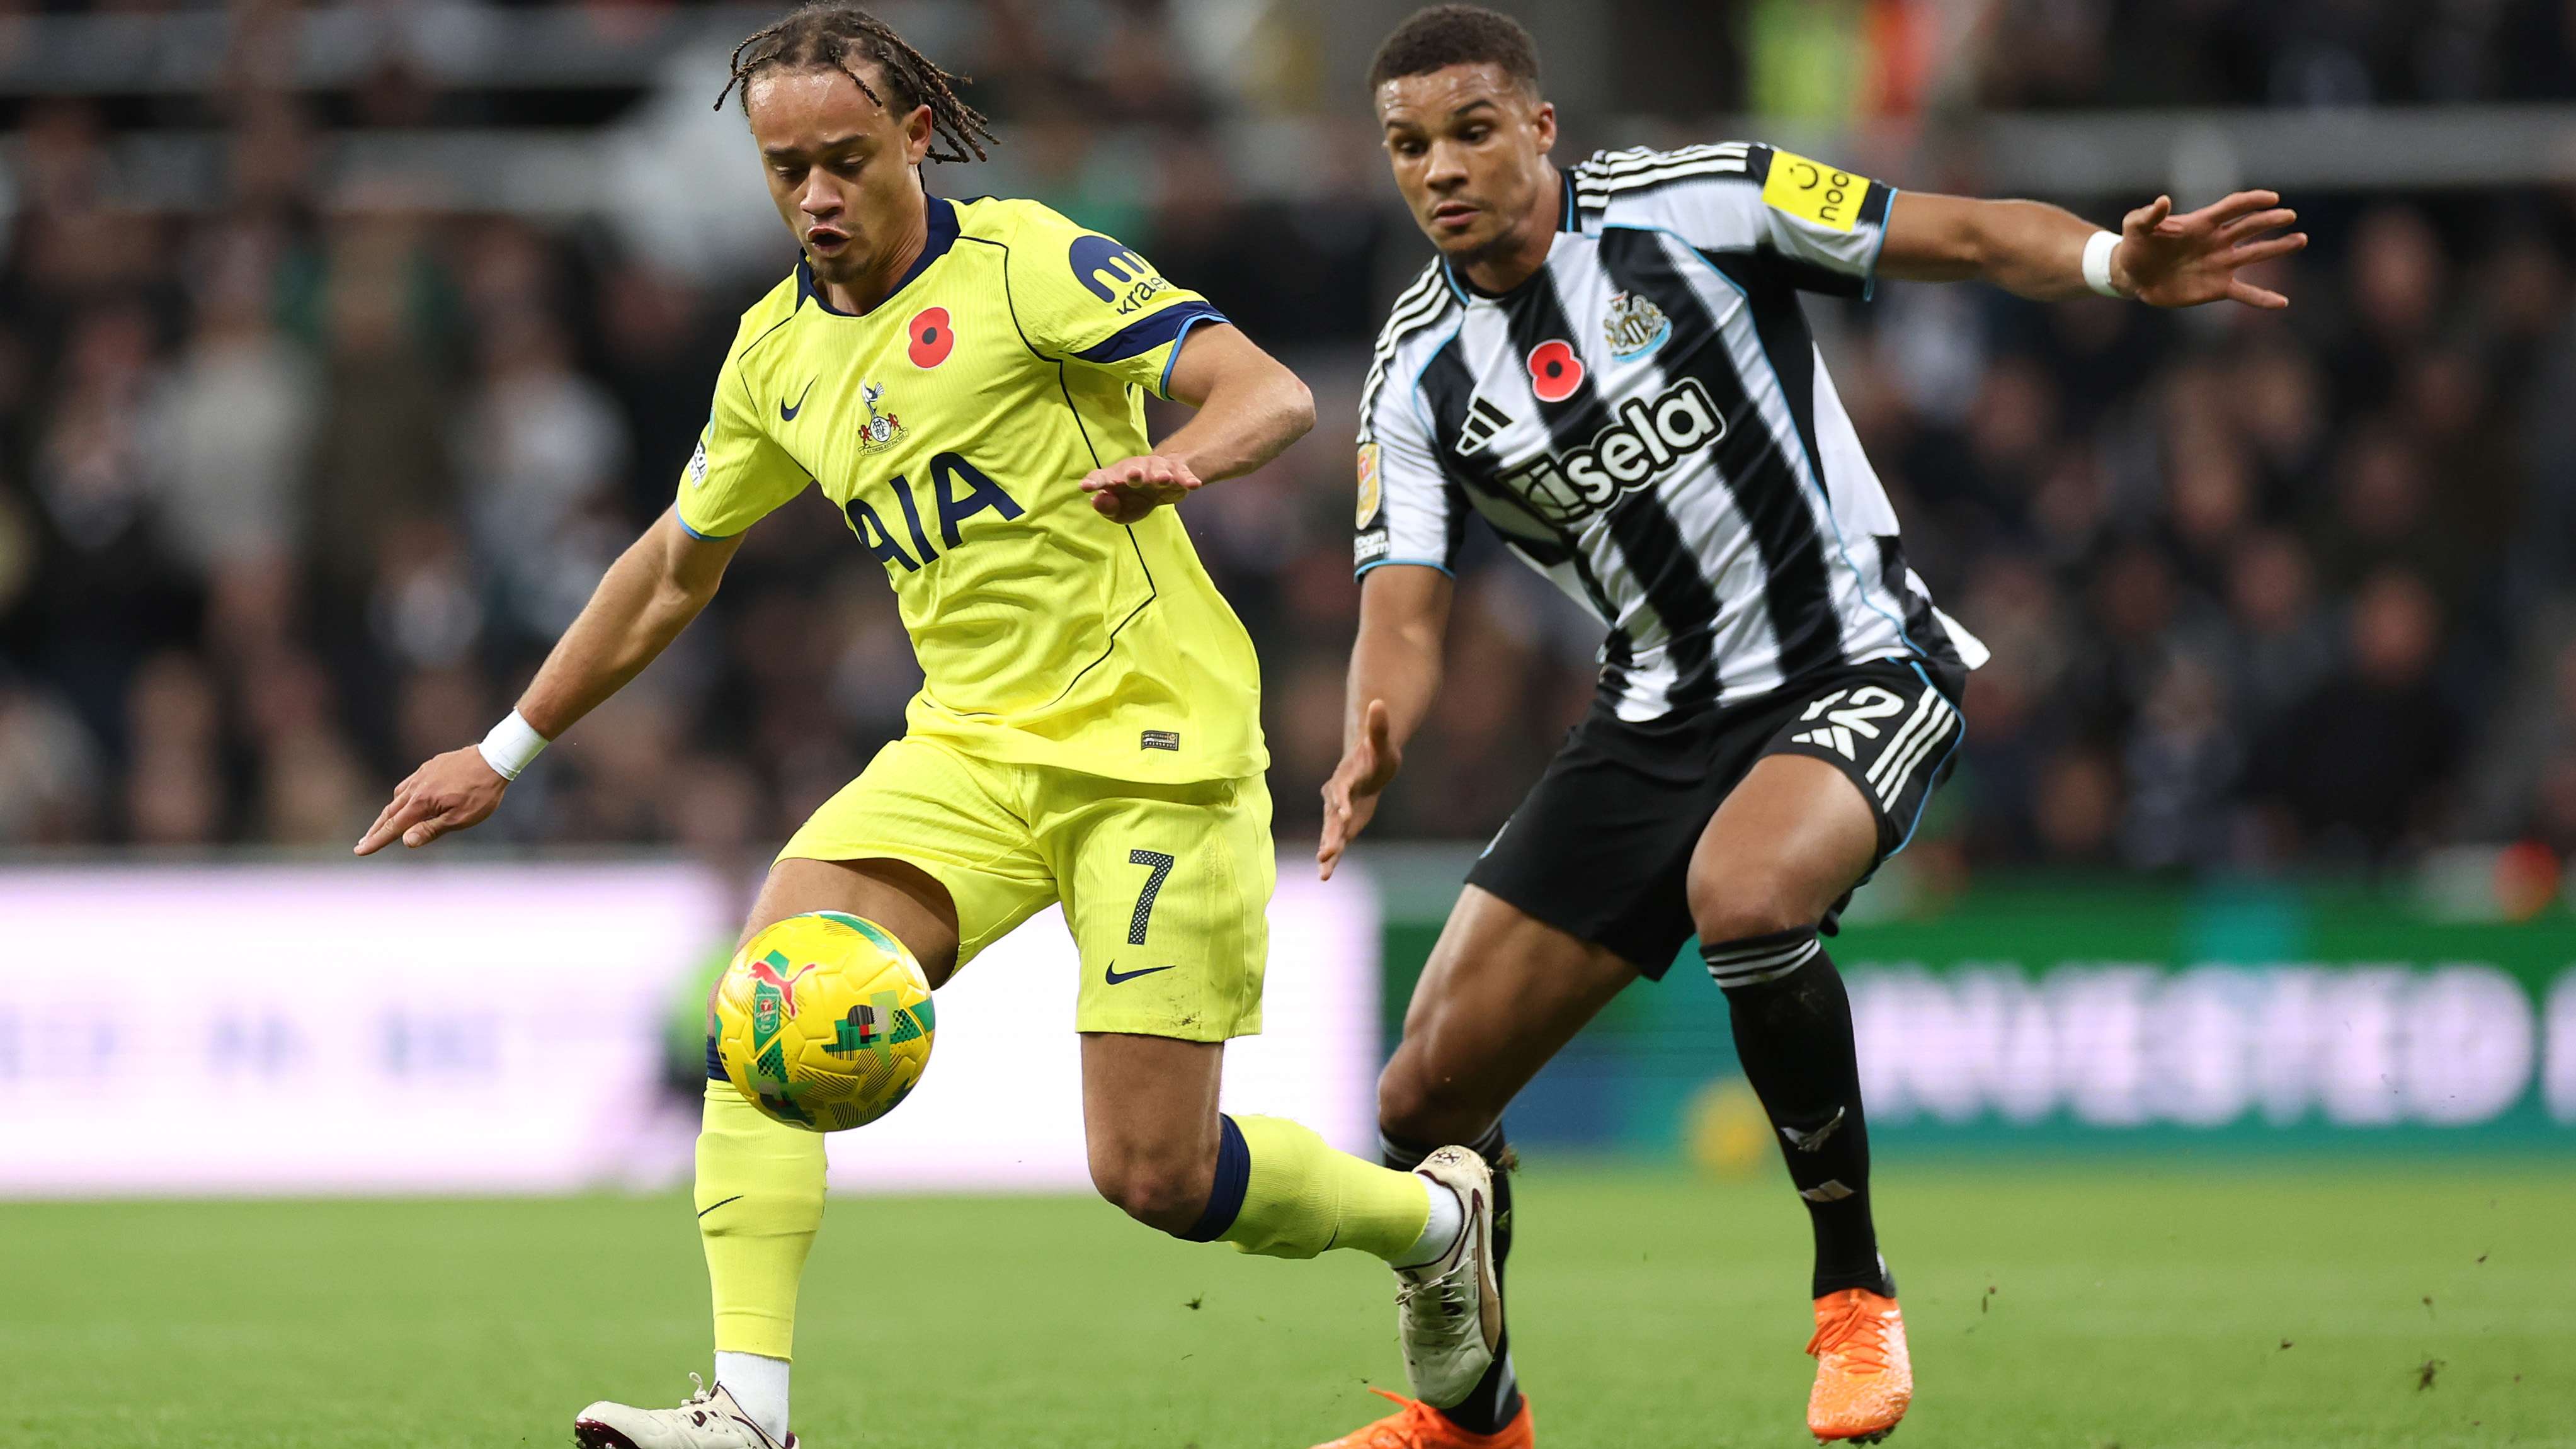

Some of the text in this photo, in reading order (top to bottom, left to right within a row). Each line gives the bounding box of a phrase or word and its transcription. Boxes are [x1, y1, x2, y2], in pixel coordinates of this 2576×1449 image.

[1566, 387, 1716, 504] sela
[845, 452, 1026, 581] AIA
[1799, 685, 1905, 739] 12
[1127, 849, 1175, 945] 7
